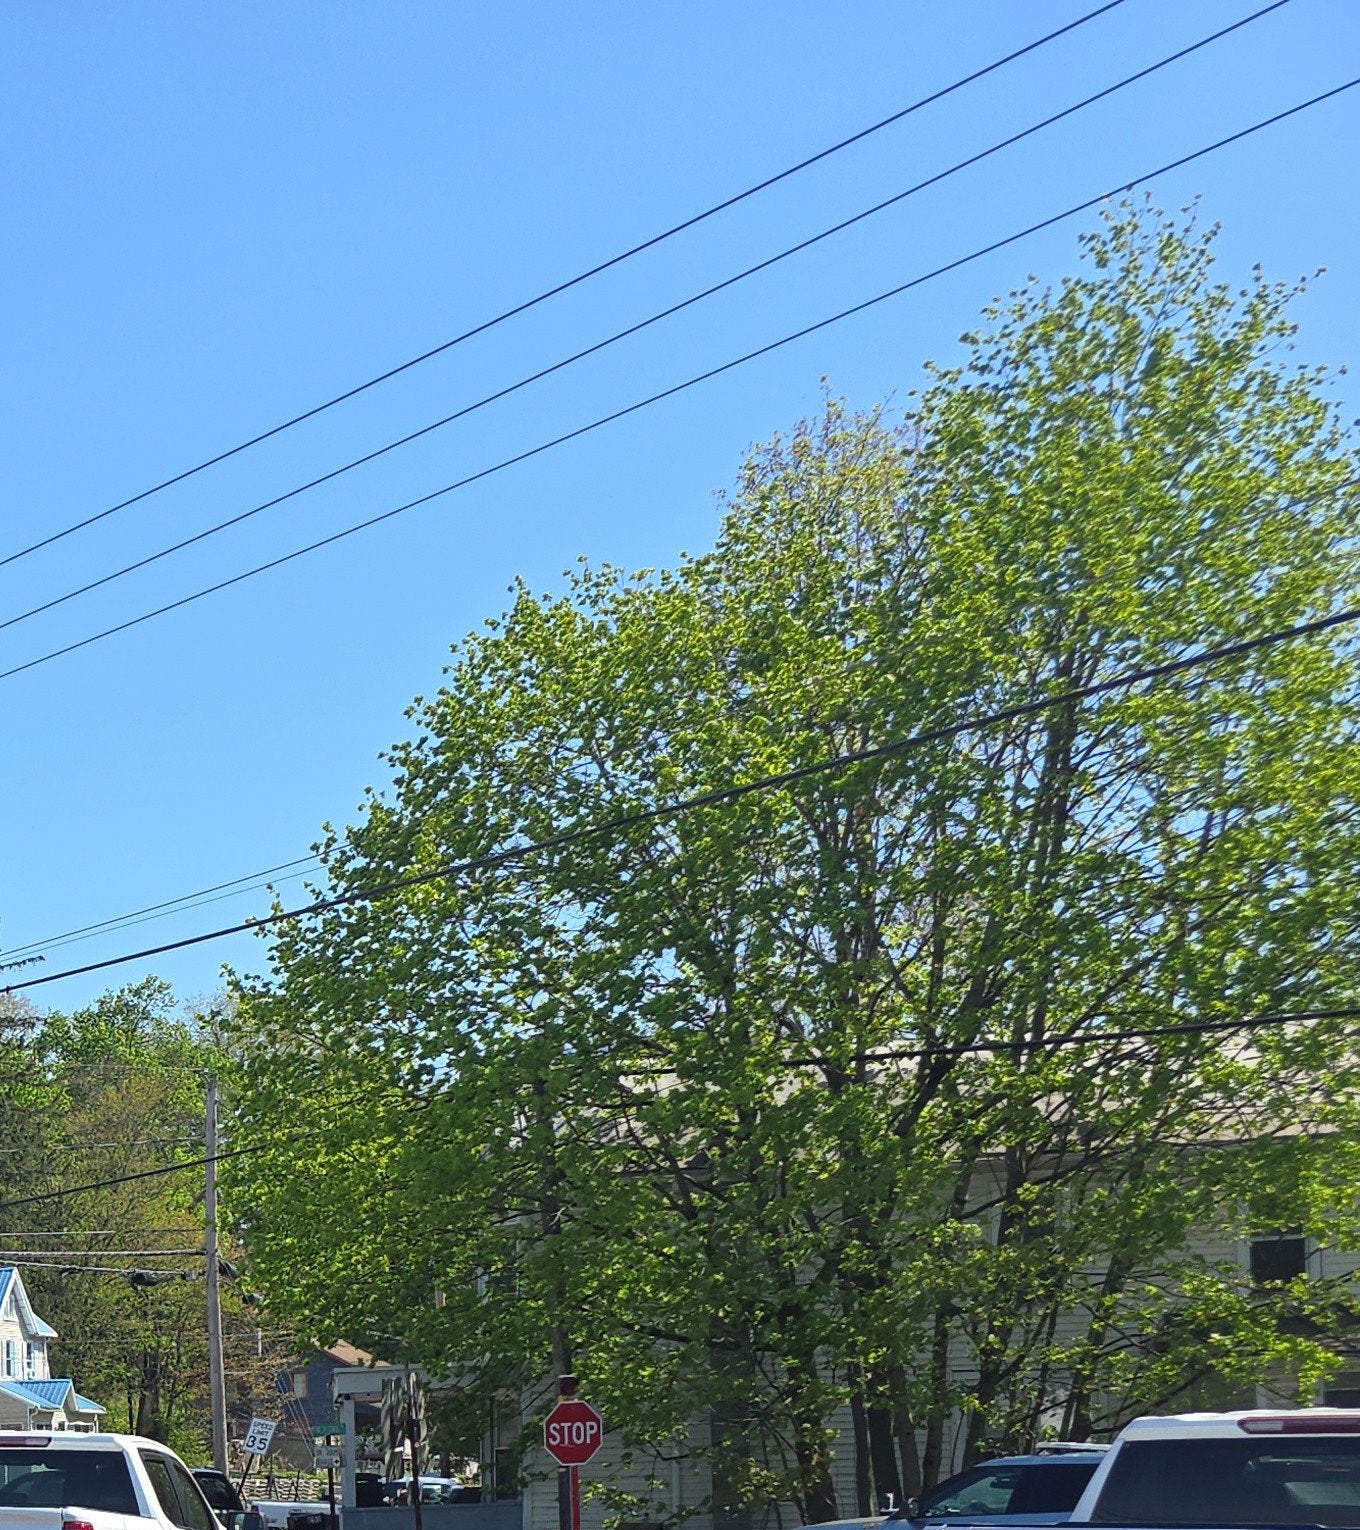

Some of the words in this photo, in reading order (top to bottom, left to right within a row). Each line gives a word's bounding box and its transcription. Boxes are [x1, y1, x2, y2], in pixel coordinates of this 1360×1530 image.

[251, 1428, 269, 1437] LIMIT
[253, 1421, 274, 1431] SPEED
[548, 1421, 598, 1446] STOP
[246, 1435, 268, 1451] 35
